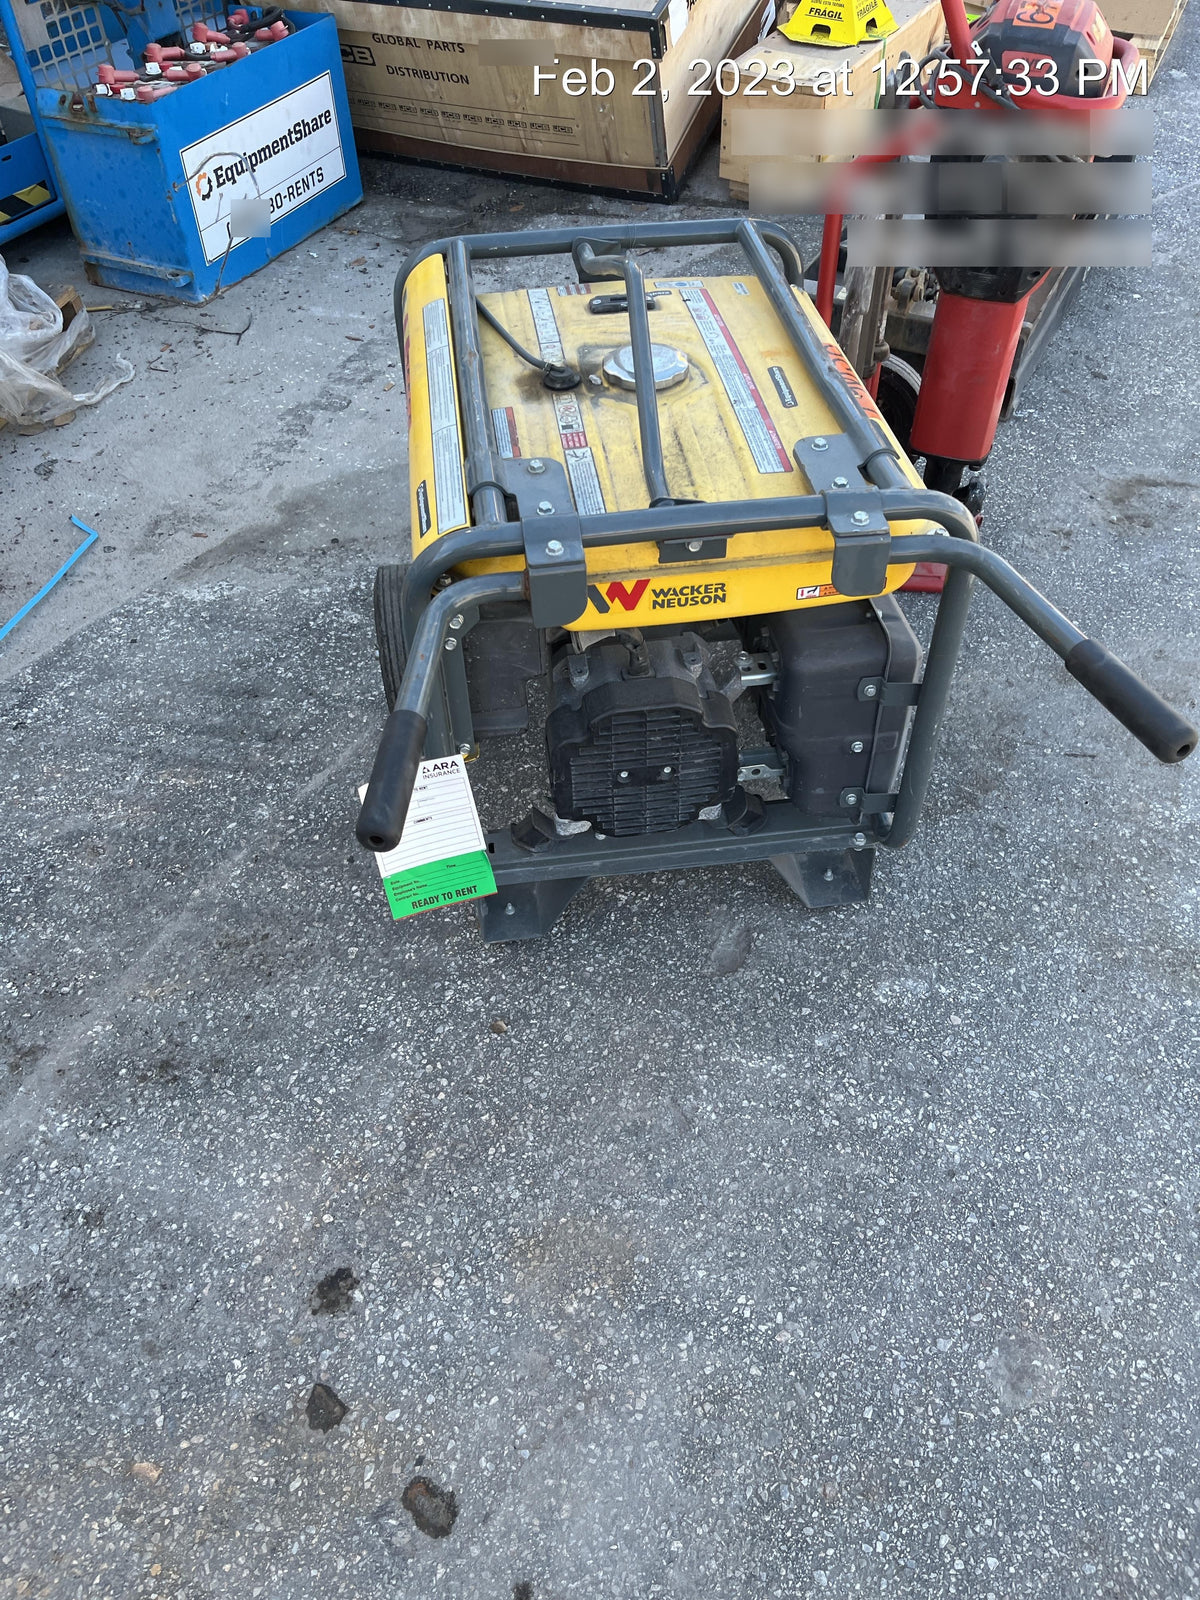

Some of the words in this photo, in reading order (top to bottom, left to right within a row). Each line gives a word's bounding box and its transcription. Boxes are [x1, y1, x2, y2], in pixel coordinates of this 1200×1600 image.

[808, 7, 843, 20] FRÁGIL
[857, 0, 878, 19] FRAGILE
[372, 33, 421, 48] GLOBAL
[427, 40, 465, 53] PARTS
[340, 44, 376, 66] CB
[386, 65, 470, 85] DISTRIBUTION
[213, 109, 332, 189] EquipmentShare
[652, 582, 726, 599] WACKER
[652, 593, 726, 609] NEUSON
[423, 768, 460, 779] INSURANCE
[433, 760, 459, 772] ARA
[411, 894, 440, 910] READY
[441, 891, 453, 901] TO
[455, 885, 478, 898] RENT
